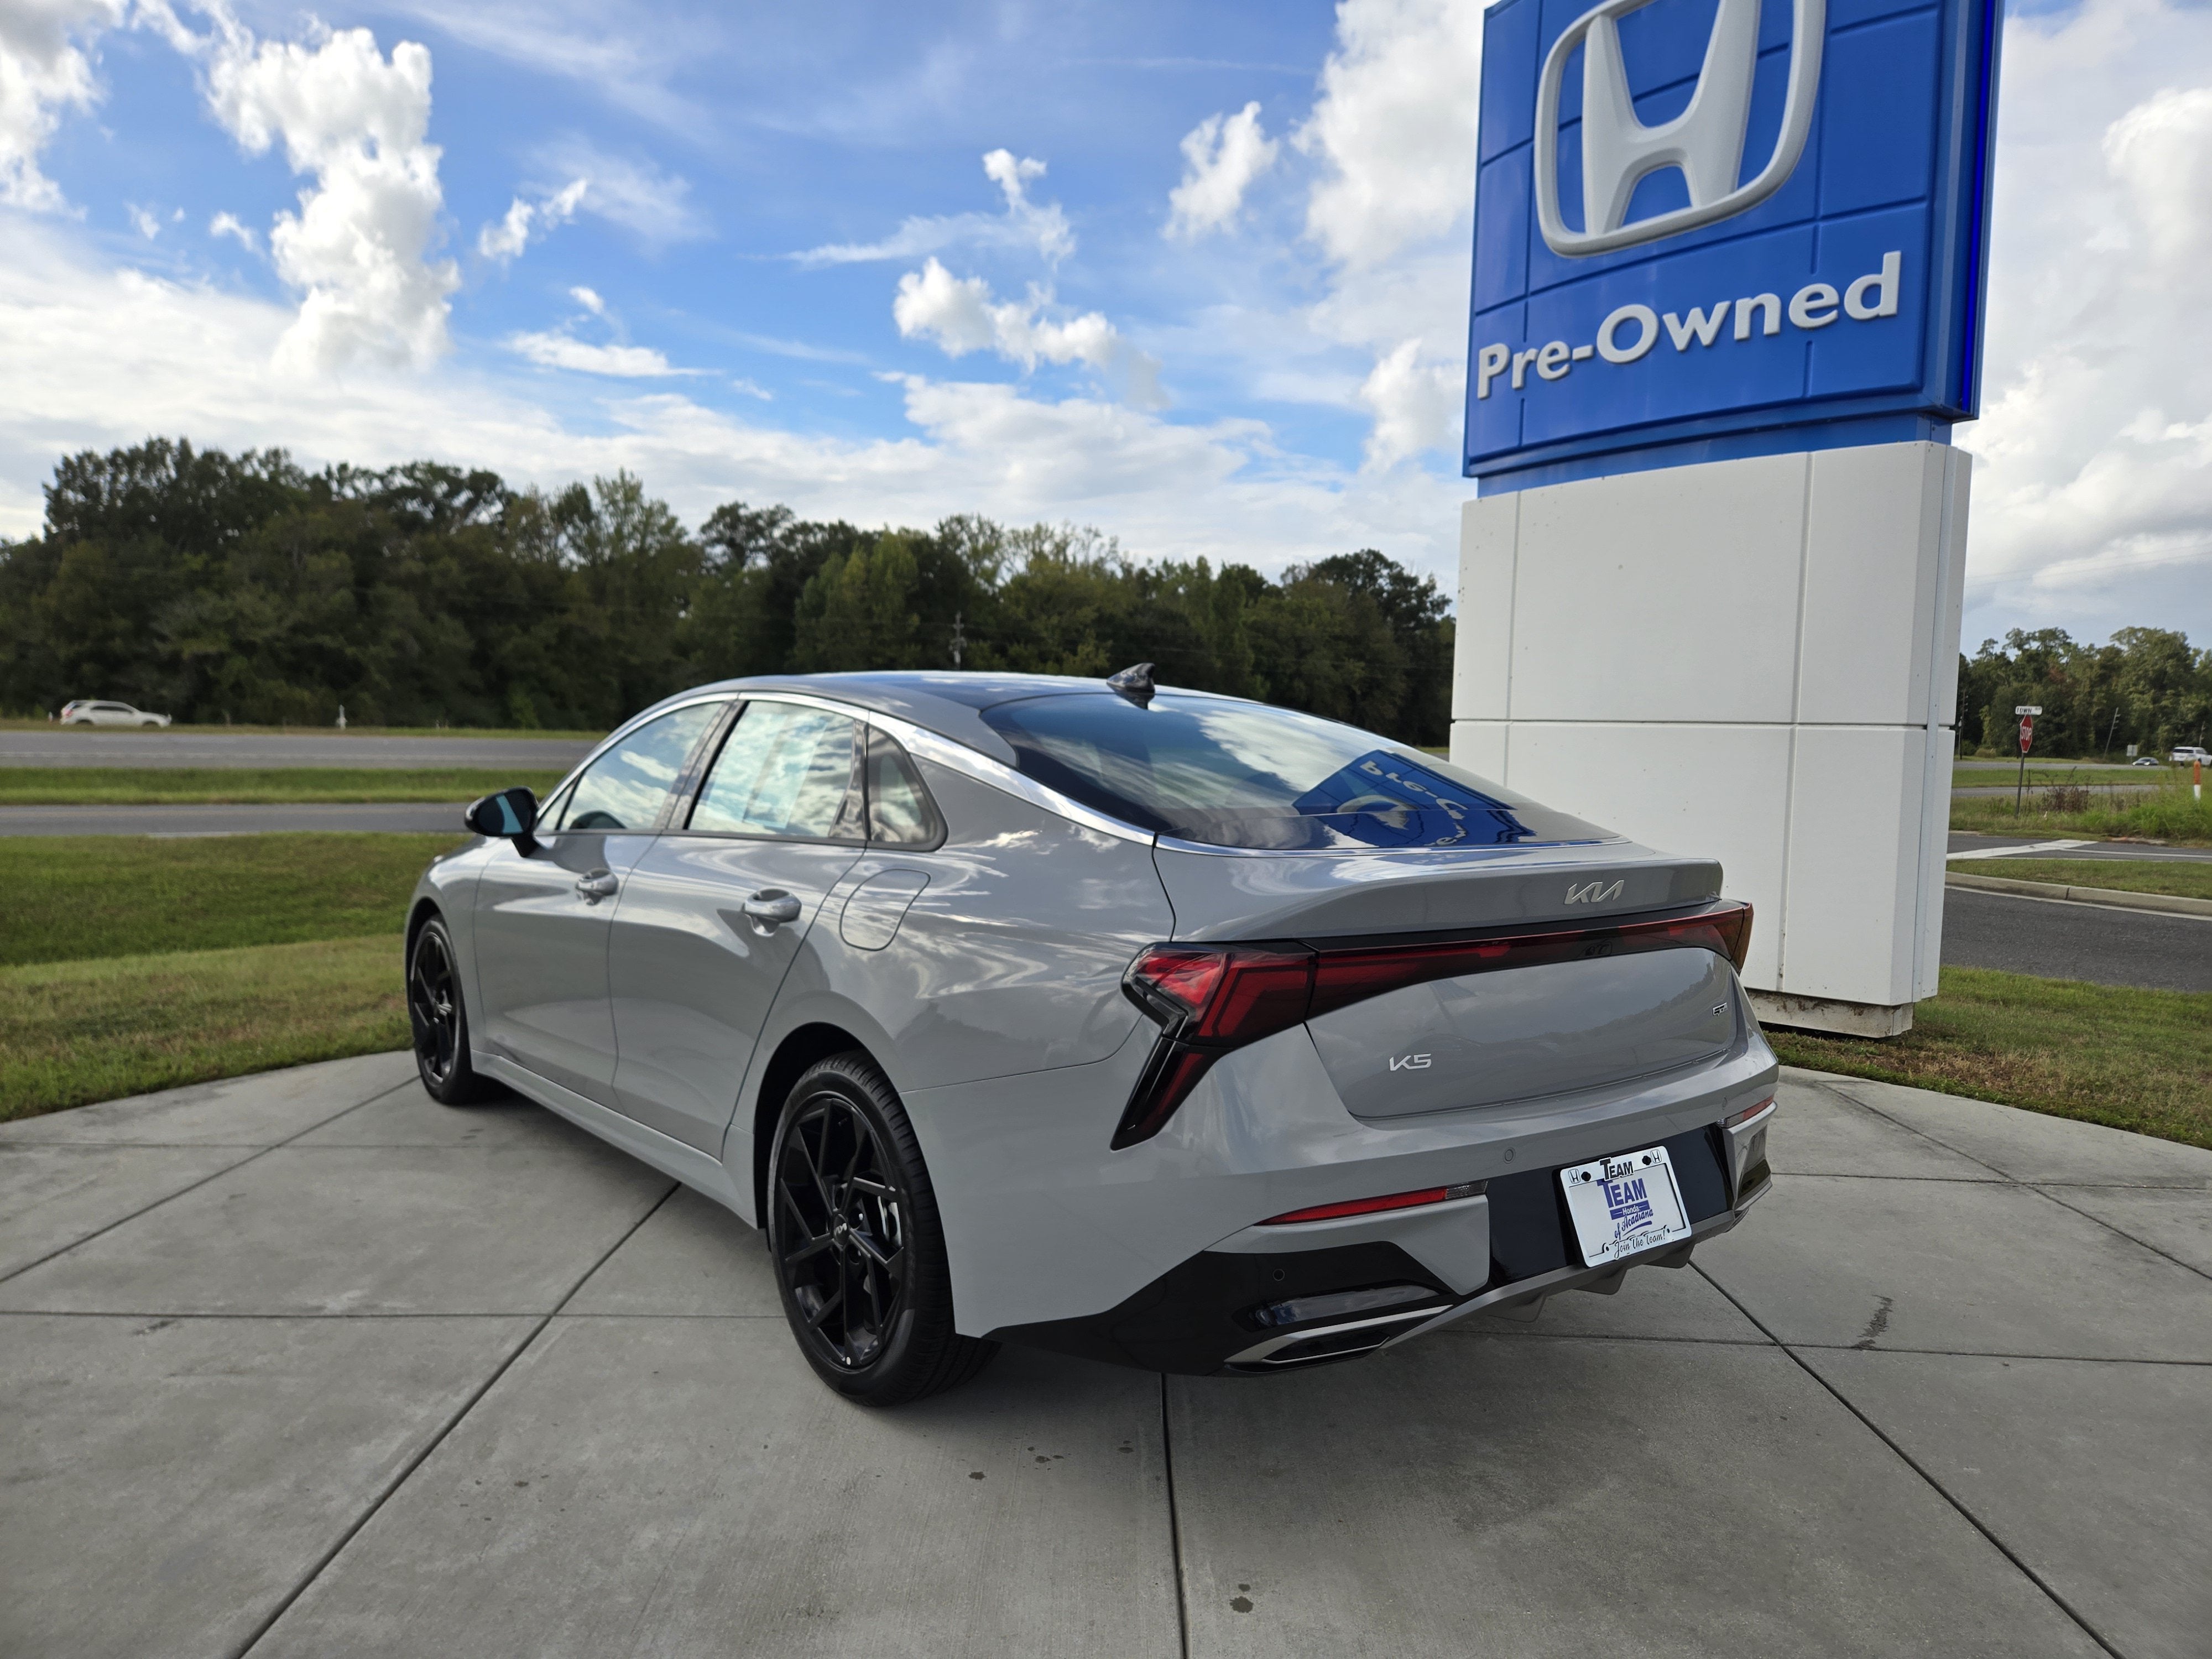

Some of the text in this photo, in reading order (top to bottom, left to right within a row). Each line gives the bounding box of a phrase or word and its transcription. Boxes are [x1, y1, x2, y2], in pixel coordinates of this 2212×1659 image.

[1477, 250, 1902, 400] Pre-Owned
[2021, 726, 2032, 741] STOP
[1389, 1053, 1432, 1071] K5
[1599, 1158, 1634, 1180] TEAM
[1597, 1178, 1647, 1208] TEAM
[1622, 1205, 1640, 1215] Honda
[1614, 1208, 1653, 1240] of Acadiana
[1614, 1241, 1630, 1259] Join
